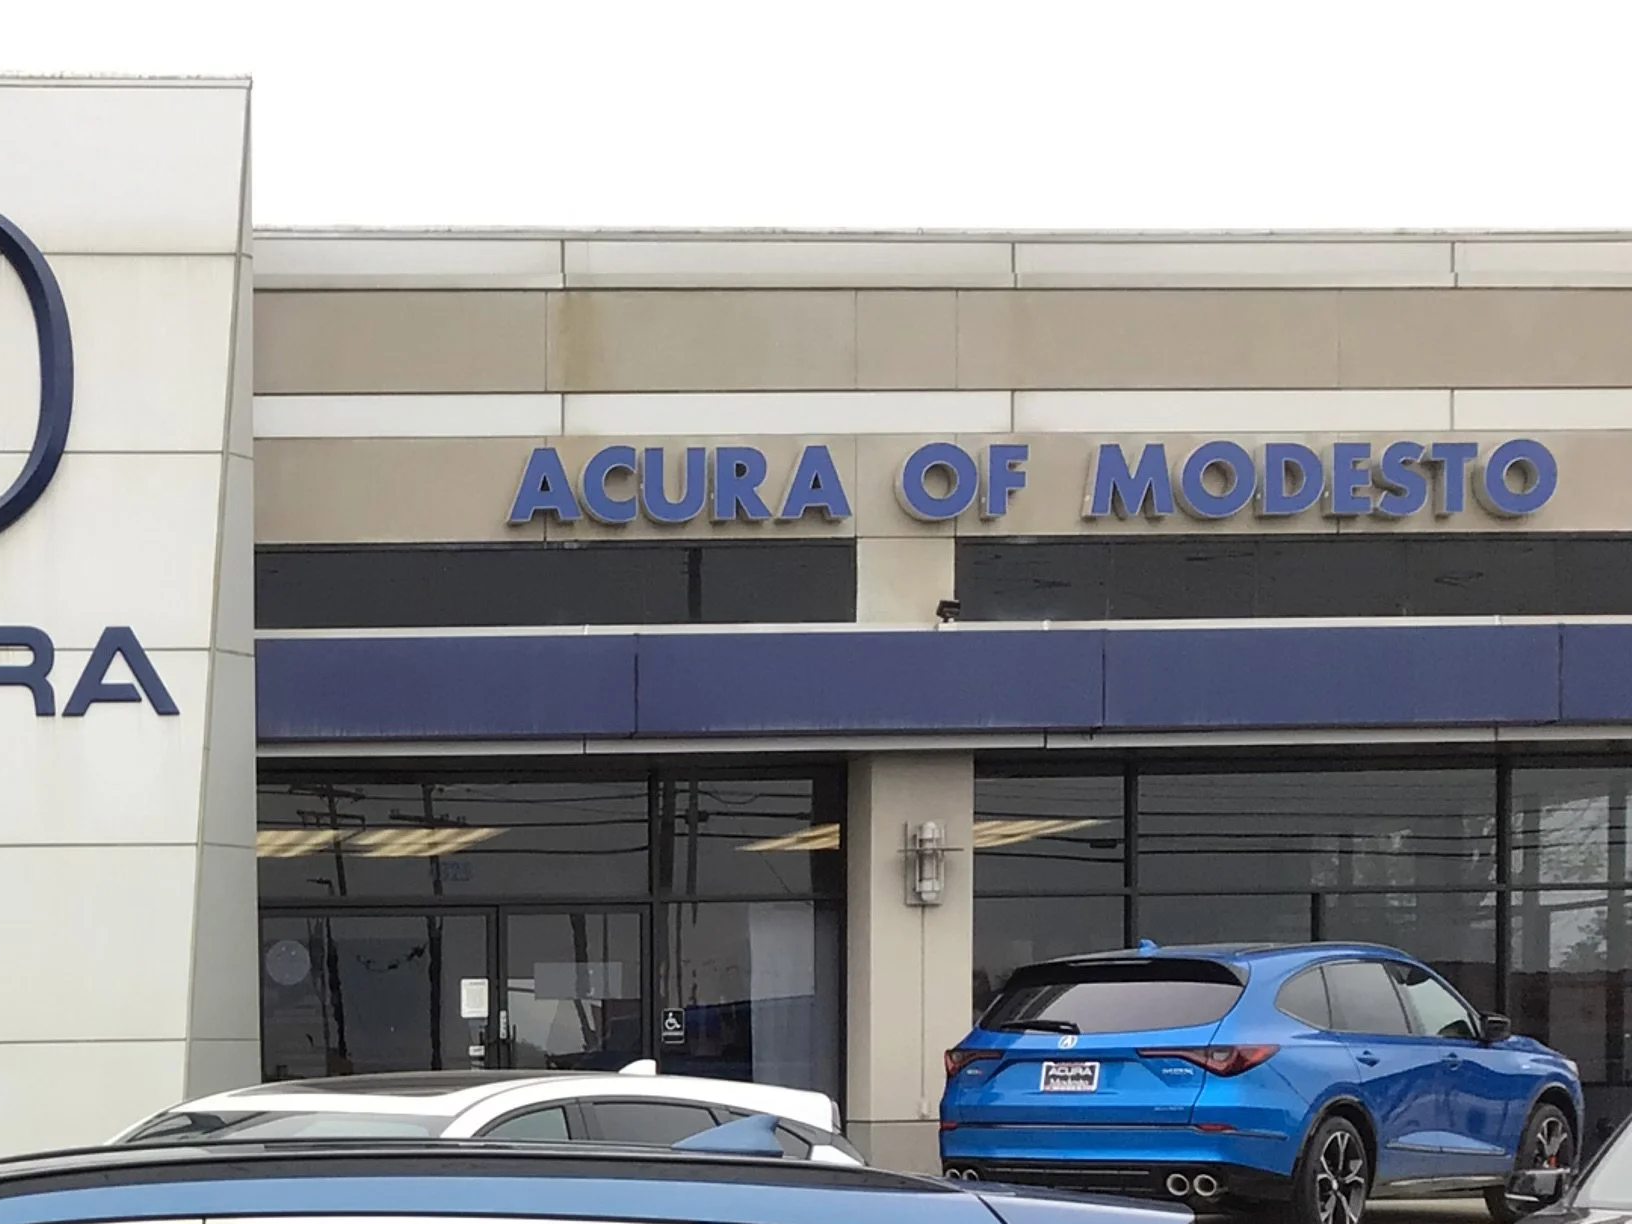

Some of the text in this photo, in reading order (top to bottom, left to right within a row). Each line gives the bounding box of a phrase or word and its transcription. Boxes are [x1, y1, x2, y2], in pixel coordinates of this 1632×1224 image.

[508, 438, 1558, 524] ACURA OF MODESTO
[1048, 1066, 1093, 1076] ACURA
